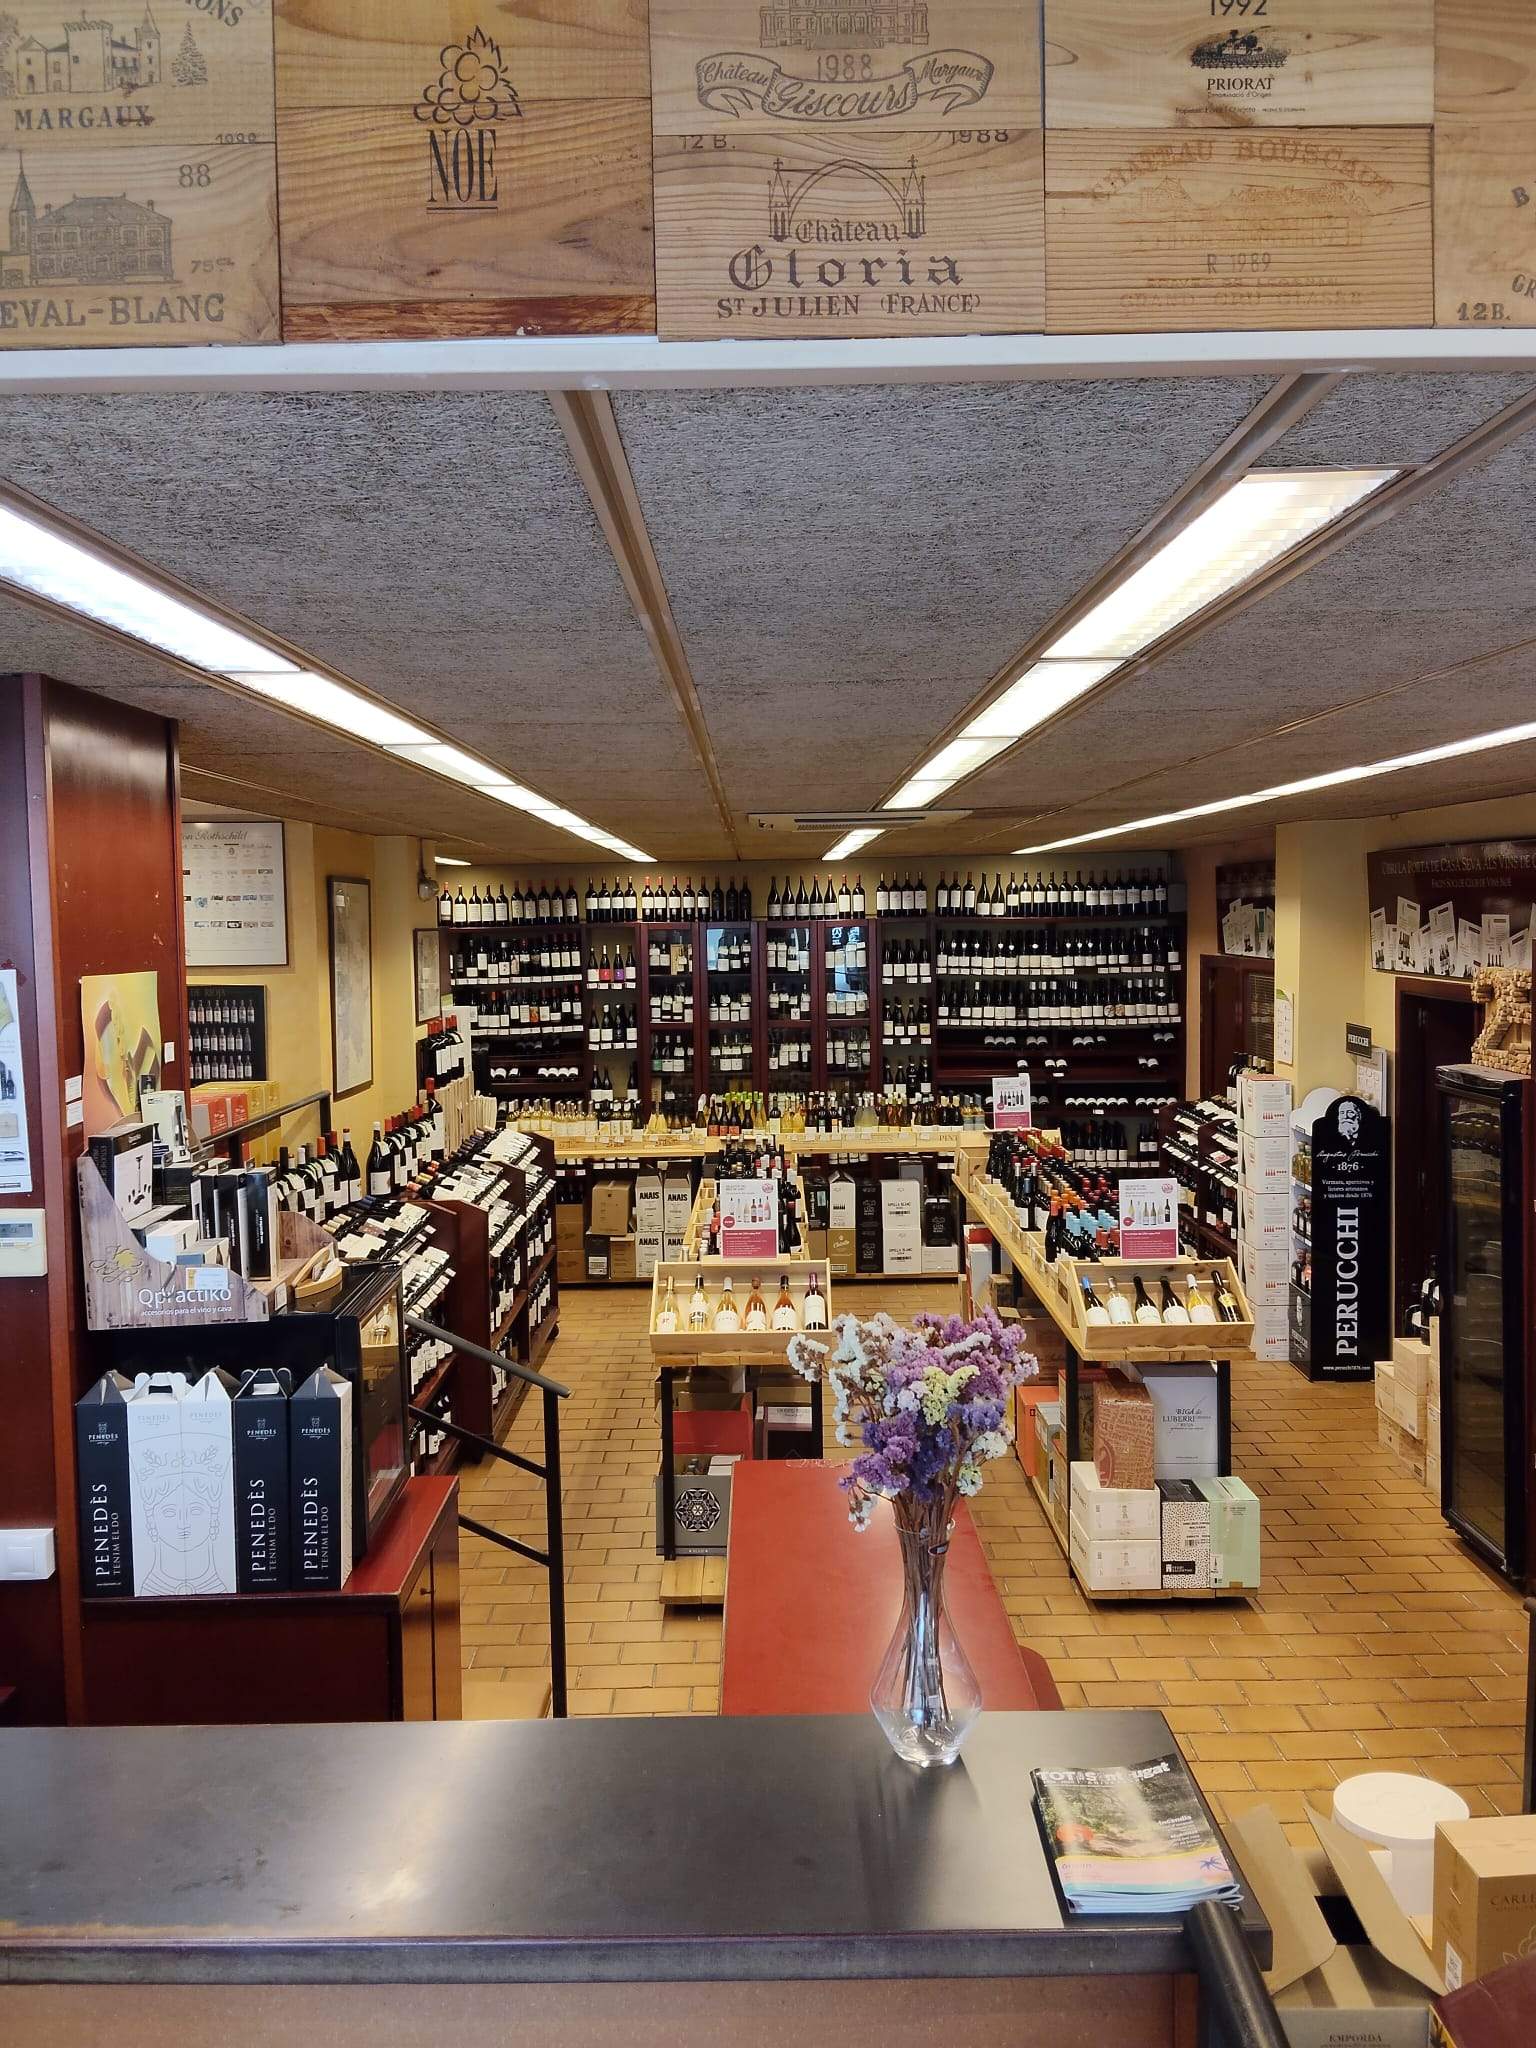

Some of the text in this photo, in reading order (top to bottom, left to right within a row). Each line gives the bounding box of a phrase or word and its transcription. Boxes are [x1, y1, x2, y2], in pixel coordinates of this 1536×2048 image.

[1210, 0, 1267, 16] 1992
[702, 61, 771, 87] Château
[816, 54, 873, 81] 1988
[917, 57, 984, 85] Margaux
[1207, 78, 1275, 91] PRIORAT
[767, 80, 911, 117] Giscours
[14, 105, 154, 130] MARGAUX
[951, 130, 1008, 144] 1988
[178, 163, 211, 188] 88
[427, 129, 498, 202] NOE
[796, 218, 900, 243] Château
[727, 244, 963, 291] Gloria
[1229, 252, 1271, 274] 1989
[752, 294, 859, 317] JULIEN
[880, 292, 981, 315] (FRANCE)
[1337, 1162, 1359, 1173] 1876
[639, 1192, 660, 1200] ANAIS
[639, 1238, 659, 1246] ANAIS
[1336, 1207, 1359, 1356] PERUCCHI
[90, 1484, 110, 1576] PENEDÈS
[247, 1479, 266, 1571] PENEDÈS
[300, 1478, 319, 1569] PENEDÈS
[111, 1512, 120, 1576] TENIM EL DO
[267, 1508, 277, 1571] TENIM EL DO
[321, 1506, 329, 1569] TENIM EL DO
